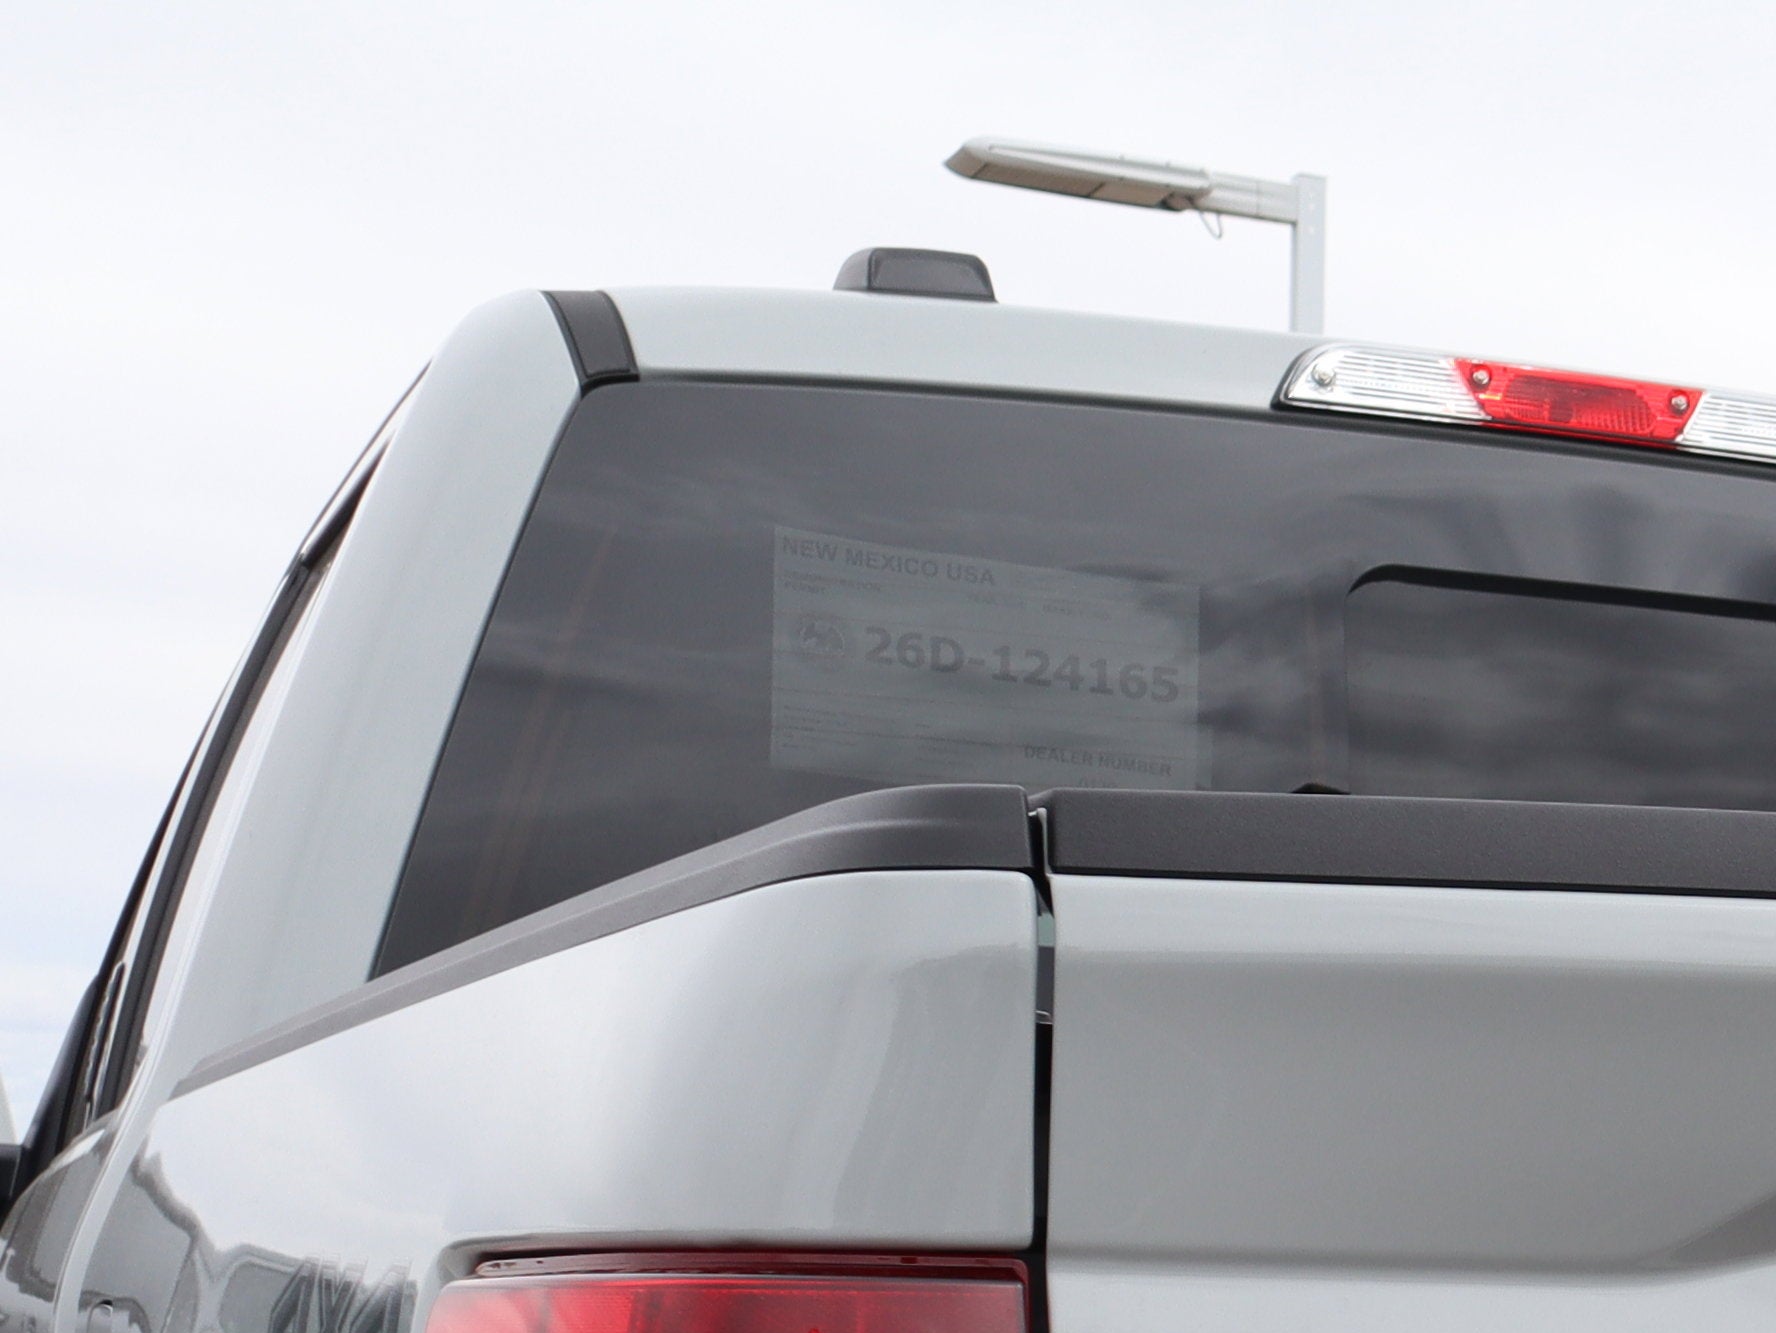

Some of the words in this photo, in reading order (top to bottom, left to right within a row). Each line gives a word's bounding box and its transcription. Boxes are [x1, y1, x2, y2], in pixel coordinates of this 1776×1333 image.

[782, 536, 838, 561] NEW
[845, 548, 939, 579] MEXICO
[946, 562, 996, 587] USA
[864, 626, 1179, 703] 26D-124165
[1024, 744, 1094, 769] DEALER
[1099, 753, 1172, 778] NUMBER
